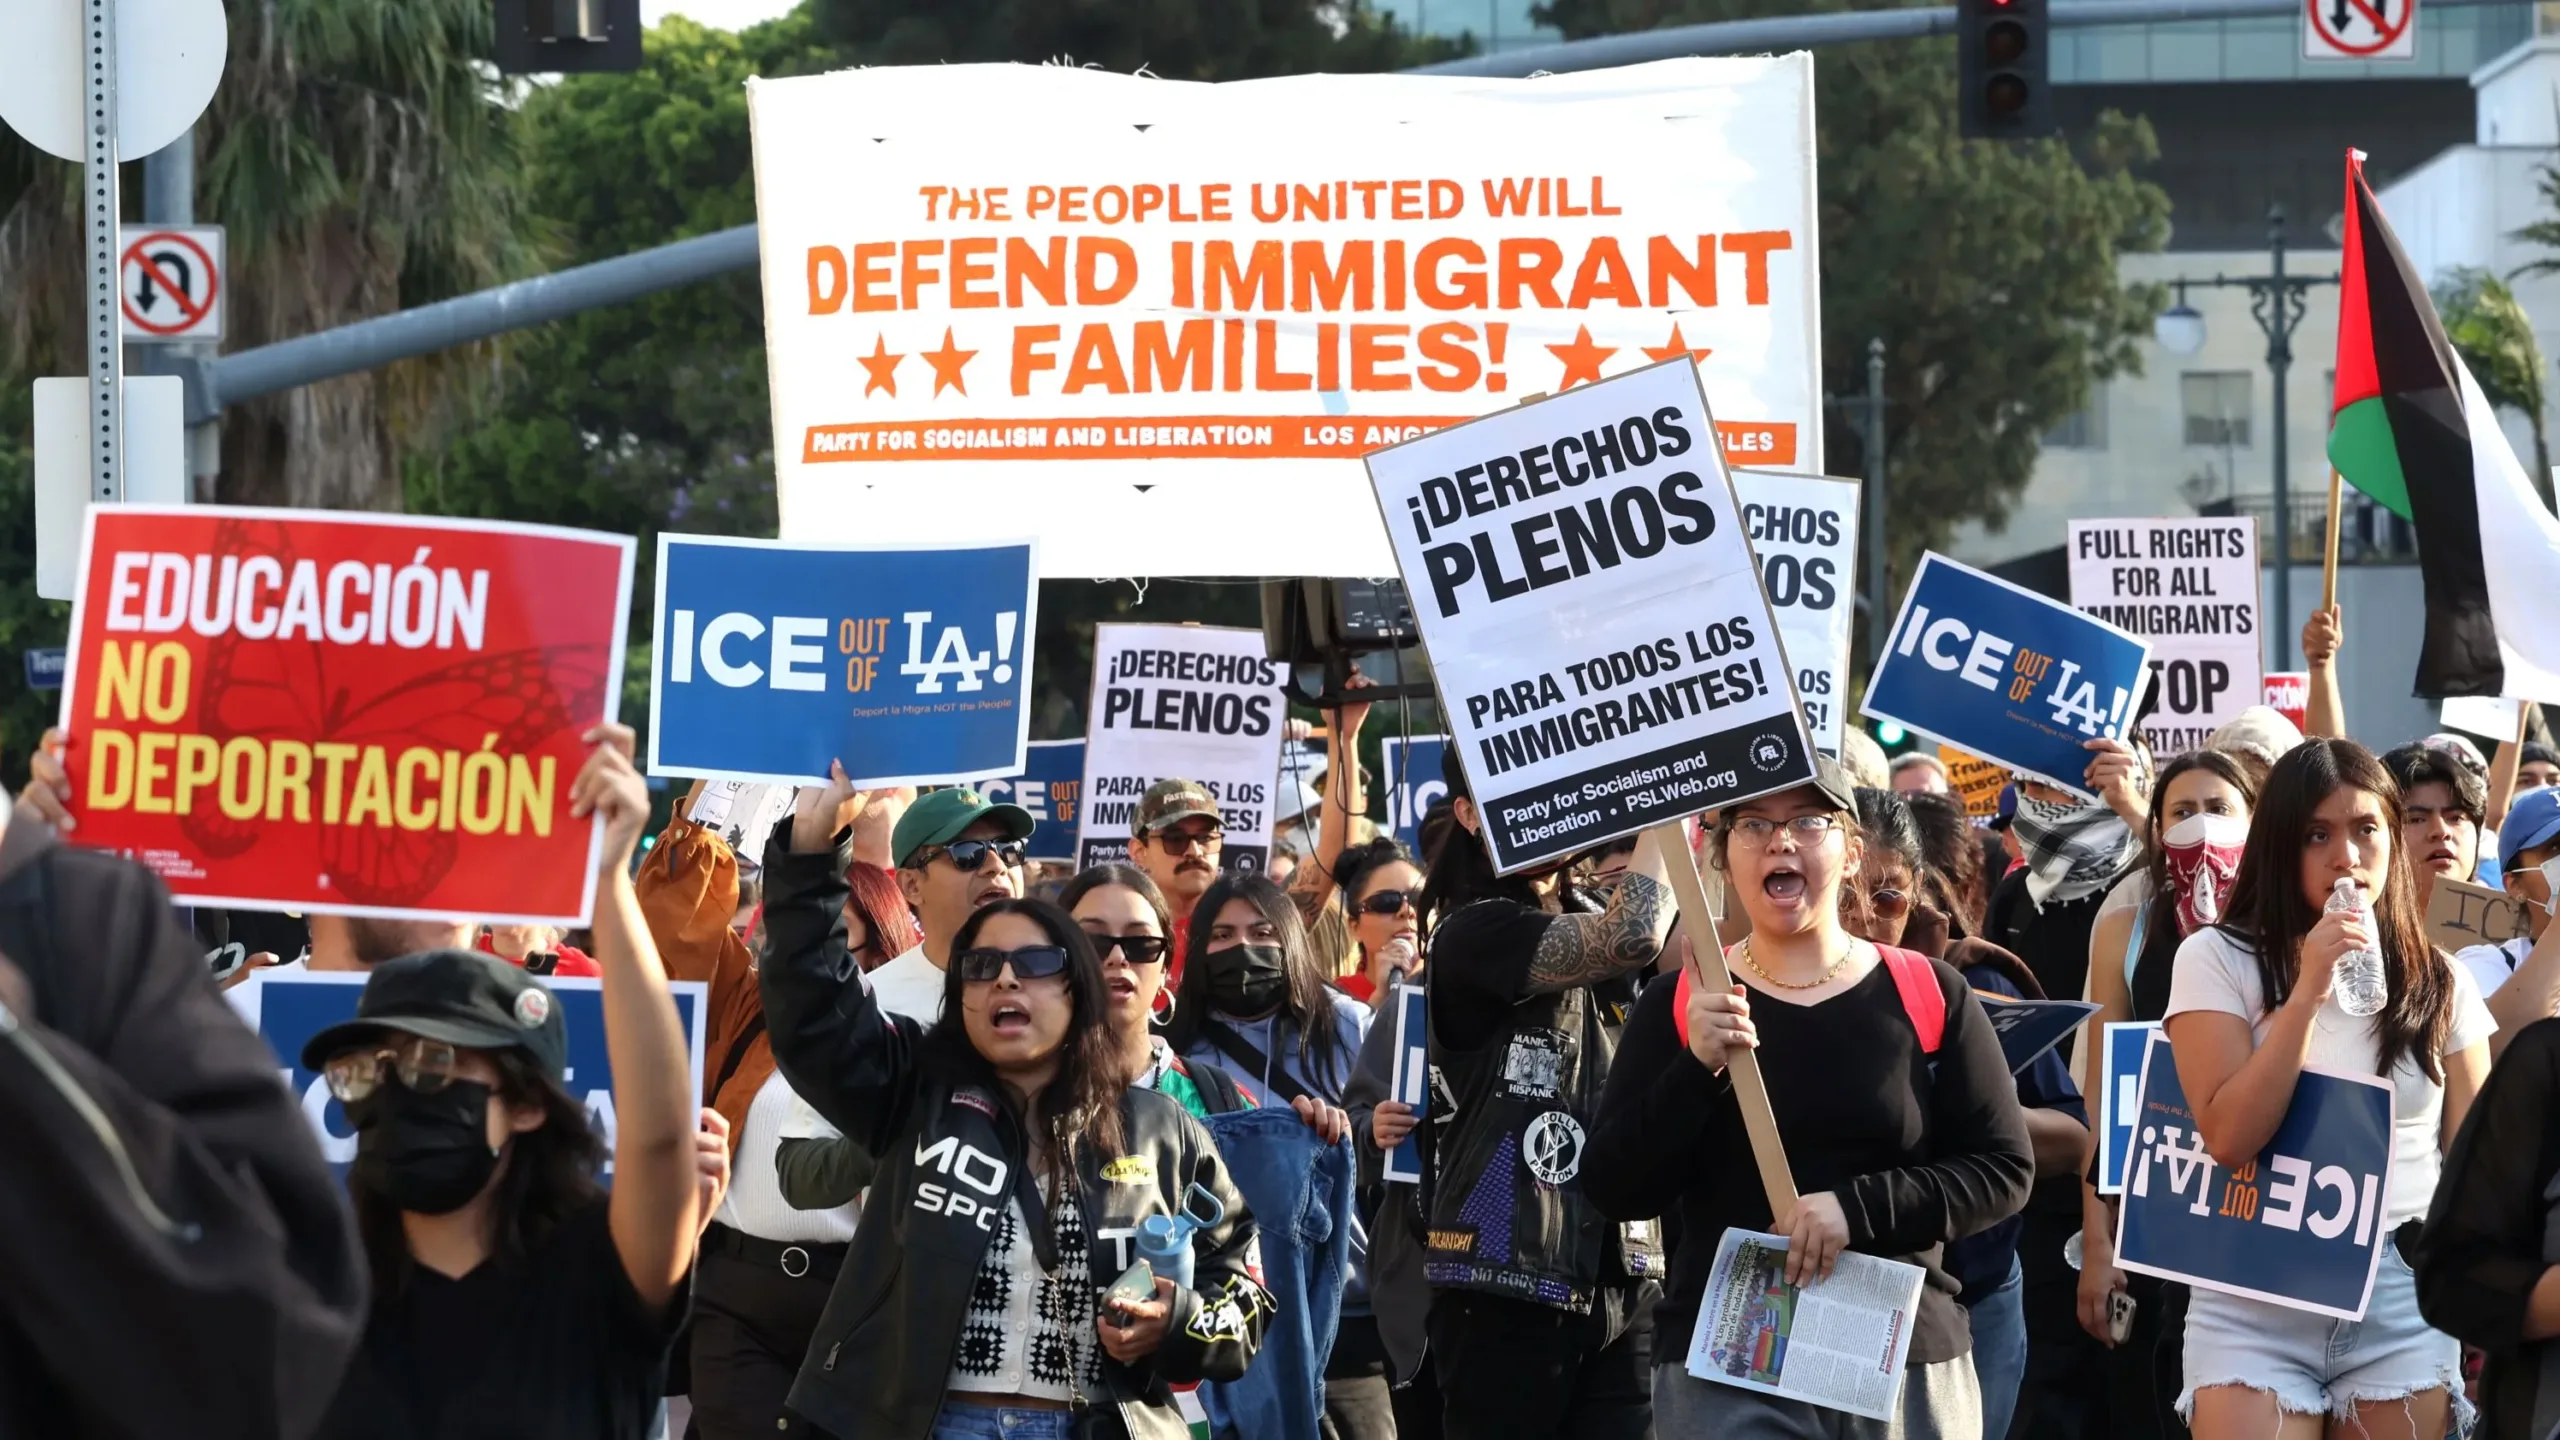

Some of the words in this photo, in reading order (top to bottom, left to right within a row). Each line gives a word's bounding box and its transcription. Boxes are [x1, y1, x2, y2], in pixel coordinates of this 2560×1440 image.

[919, 185, 1013, 223] THE
[1026, 182, 1233, 224] PEOPLE
[1250, 179, 1464, 223] UNITED
[1481, 176, 1623, 218] WILL
[806, 236, 1138, 315] DEFEND
[1171, 230, 1792, 313] IMMIGRANT
[1010, 318, 1509, 397] FAMILIES!
[812, 434, 871, 453] PARTY
[876, 432, 917, 449] FOR
[923, 427, 1048, 448] SOCIALISM
[1054, 427, 1106, 447] AND
[1114, 426, 1272, 447] LIBERATION
[1303, 425, 1355, 445] LOS
[1363, 425, 1439, 445] ANG
[1720, 431, 1774, 452] LES
[1406, 406, 1692, 545] ¡DERECHOS
[1422, 471, 1716, 619] PLENOS
[2079, 529, 2141, 560] FULL
[2149, 527, 2245, 558] RIGHTS
[104, 545, 490, 651] EDUCACIÓN
[2112, 568, 2161, 597] FOR
[2170, 568, 2217, 596] ALL
[671, 609, 829, 692] ICE
[839, 618, 891, 654] OUT
[900, 611, 1017, 695] LA!
[1108, 649, 1277, 686] ¡DERECHOS
[1897, 604, 2014, 692] ICE
[2013, 647, 2054, 682] OUT
[94, 640, 192, 722] NO
[847, 656, 880, 693] OF
[1465, 672, 1566, 730] PARA
[1566, 637, 1681, 697] TODOS
[1686, 615, 1756, 663] LOS
[2008, 675, 2038, 704] OF
[853, 706, 888, 718] Deport
[903, 705, 930, 715] Migra
[934, 703, 956, 712] NOT
[960, 703, 975, 711] the
[979, 699, 1012, 710] People
[1103, 688, 1271, 737] PLENOS
[1478, 658, 1769, 777] INMIGRANTES!
[86, 729, 556, 837] DEPORTACIÓN
[966, 779, 1048, 821] CE
[1051, 780, 1080, 802] OUT
[1096, 777, 1146, 798] PARA
[1226, 782, 1266, 805] LOS
[1502, 800, 1550, 826] Party
[1553, 789, 1579, 811] for
[1582, 763, 1670, 801] Socialism
[1673, 750, 1708, 776] and
[1056, 801, 1076, 823] OF
[1509, 809, 1601, 848] Liberation
[1625, 769, 1738, 813] PSLWeb.org
[1090, 844, 1117, 858] Party
[1513, 1034, 1548, 1047] MANIC
[1508, 1084, 1555, 1098] HISPANIC
[1542, 1113, 1580, 1133] DOLLY
[1530, 1160, 1573, 1183] PARTON
[2218, 1181, 2258, 1221] OUT
[2261, 1153, 2379, 1247] ICE
[1720, 1277, 1737, 1323] problemas
[1736, 1236, 1751, 1267] mundo
[1732, 1287, 1745, 1312] todas
[1738, 1274, 1748, 1288] las
[1700, 1330, 1711, 1354] Mariela
[1706, 1308, 1716, 1330] Castro
[1726, 1325, 1735, 1341] son
[1728, 1312, 1738, 1324] de
